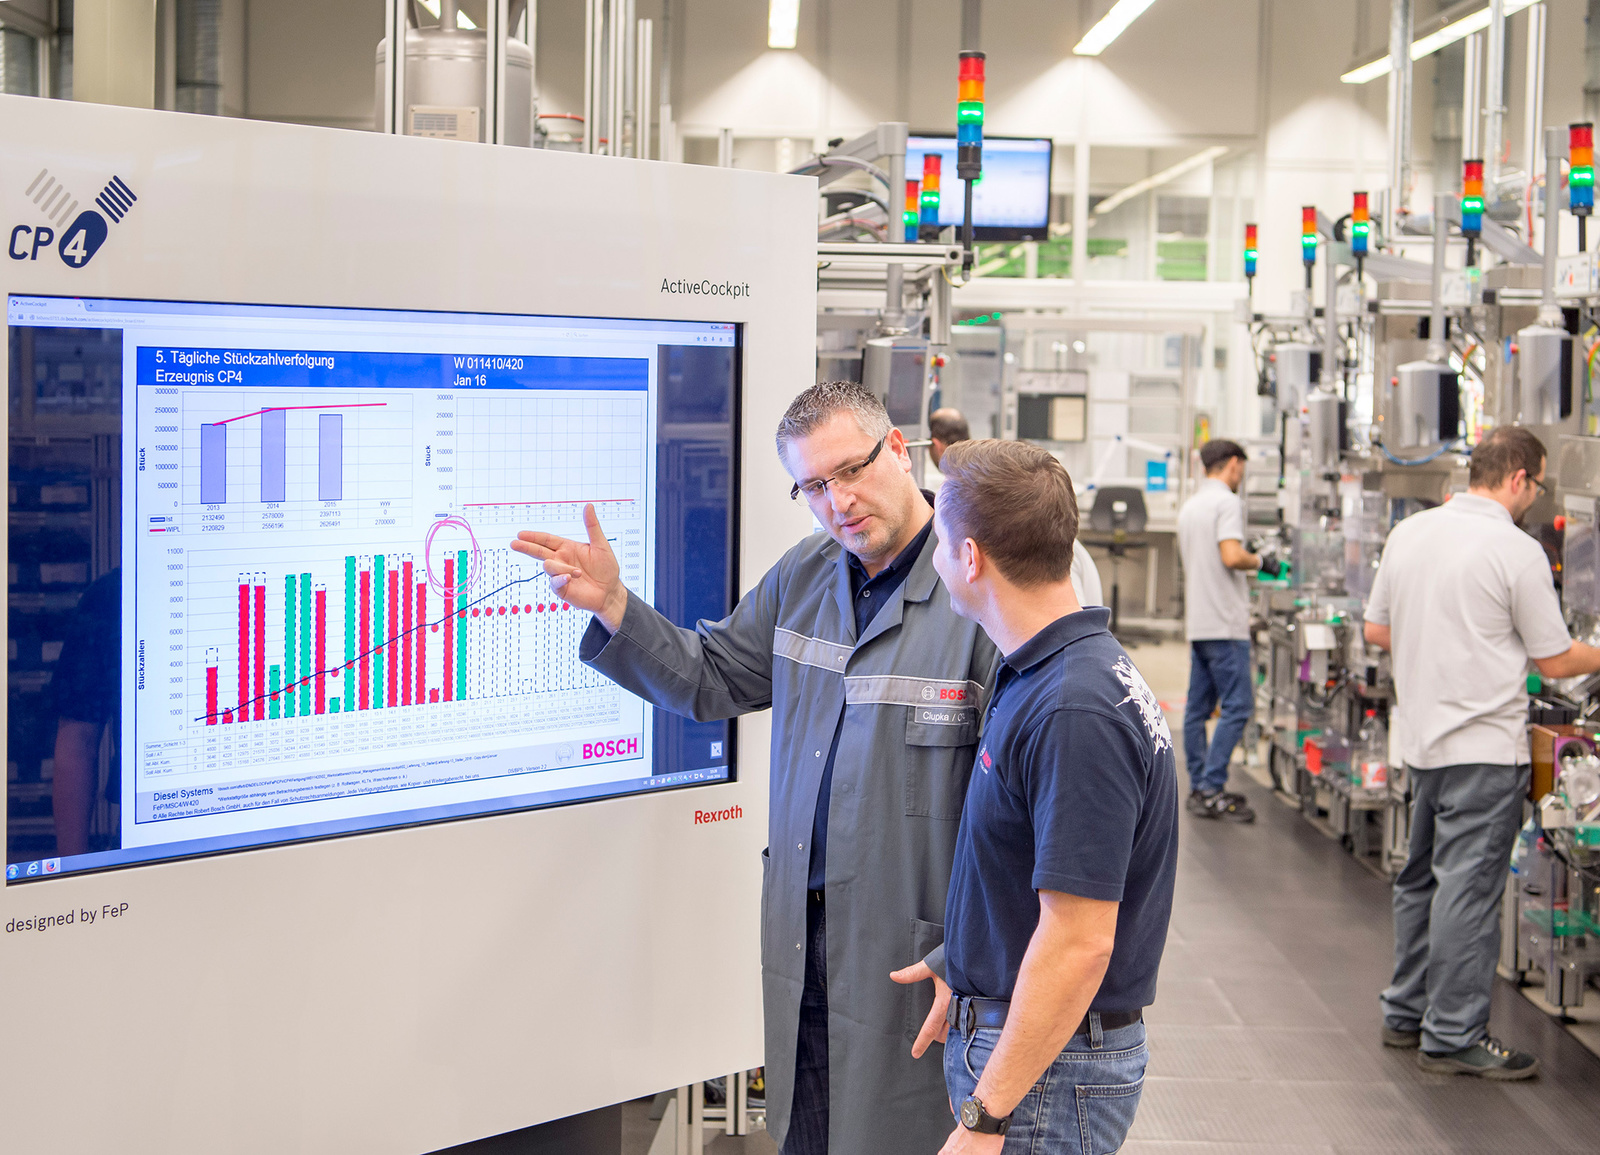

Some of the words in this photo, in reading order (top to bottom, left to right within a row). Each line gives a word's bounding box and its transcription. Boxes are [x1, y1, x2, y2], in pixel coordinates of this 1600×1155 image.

[8, 224, 54, 261] CP
[63, 229, 87, 264] 4
[660, 278, 750, 299] ActiveCockpit
[156, 350, 167, 363] 5.
[171, 351, 220, 367] Tägliche
[224, 352, 335, 369] Stückzahlverfolgung
[453, 358, 467, 369] W
[467, 358, 524, 371] 011410/420
[156, 369, 215, 386] Erzeugnis
[218, 371, 243, 383] CP4
[454, 374, 472, 386] Jan
[475, 375, 487, 386] 16
[138, 639, 146, 691] Stückzahlen
[940, 689, 967, 701] BOS
[583, 738, 638, 760] BOSCH
[154, 791, 179, 801] Diesel
[180, 788, 214, 799] Systems
[694, 805, 743, 825] Rexroth
[6, 910, 75, 933] designed
[81, 908, 98, 924] by
[102, 902, 129, 919] FeP
